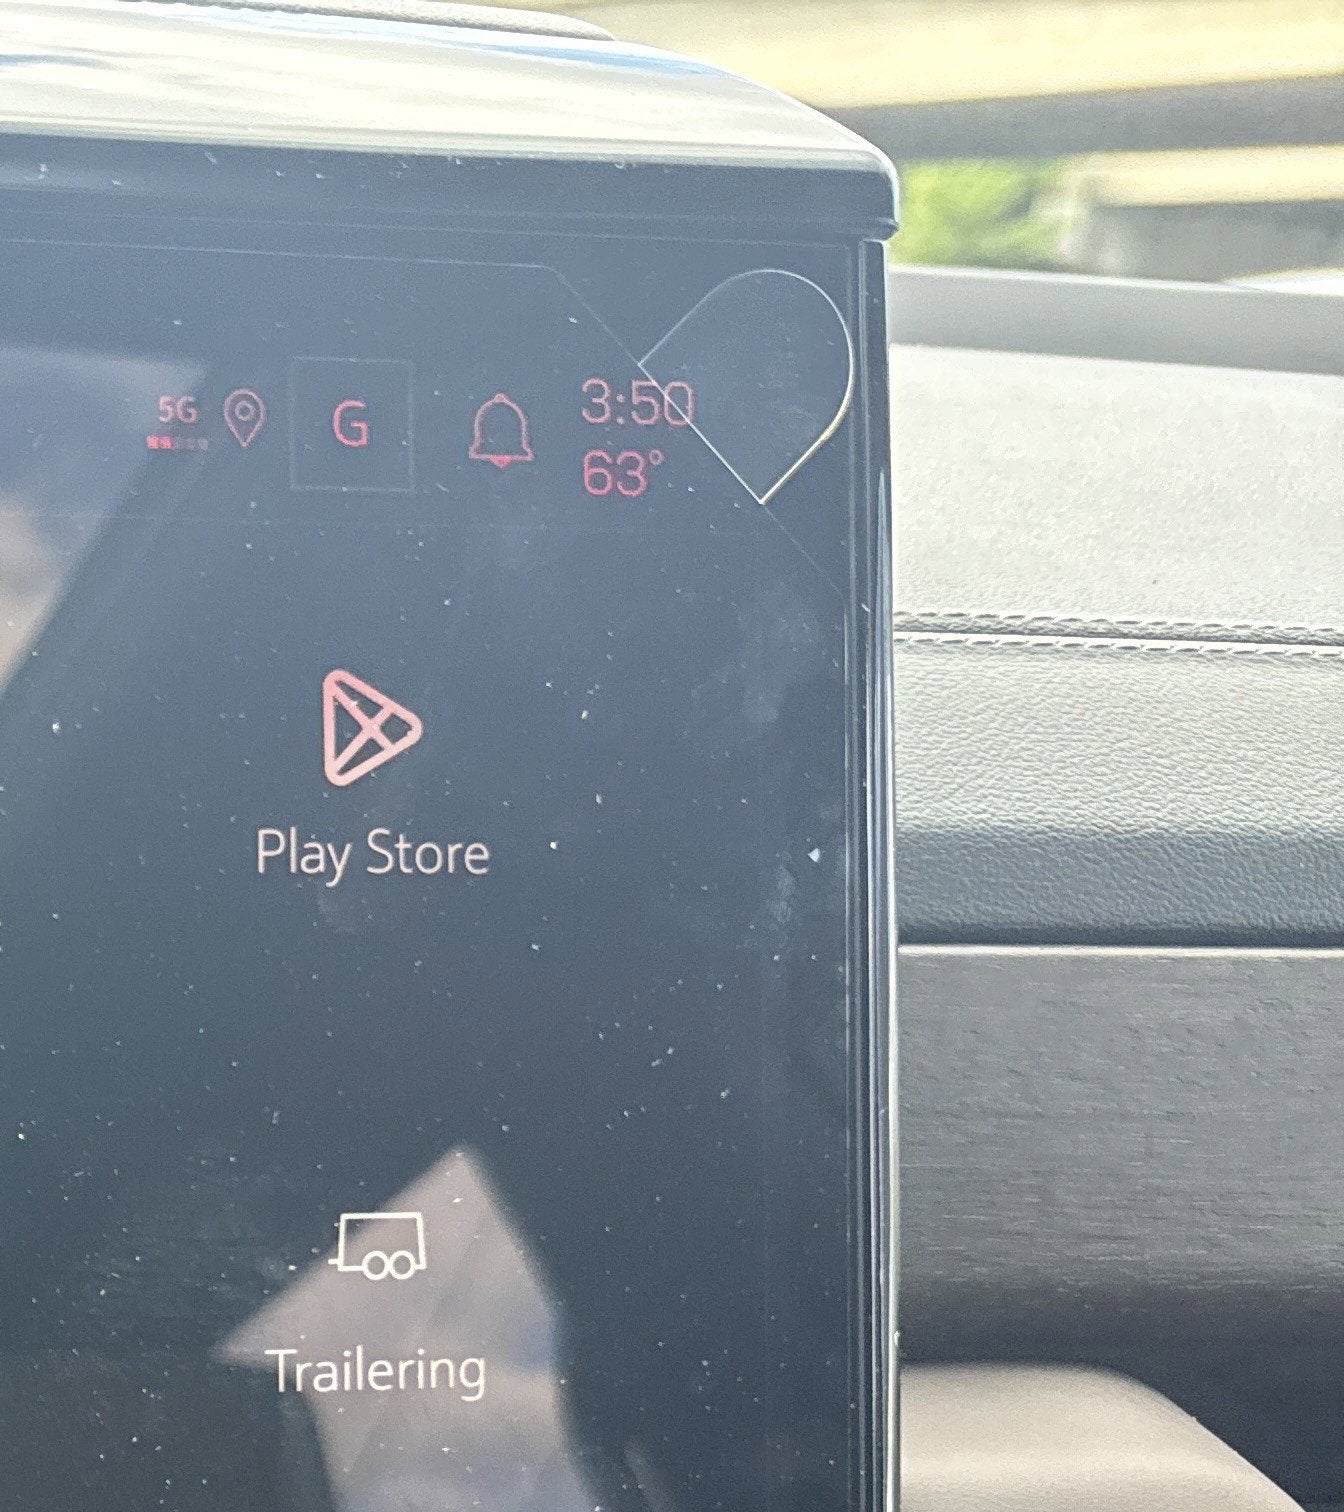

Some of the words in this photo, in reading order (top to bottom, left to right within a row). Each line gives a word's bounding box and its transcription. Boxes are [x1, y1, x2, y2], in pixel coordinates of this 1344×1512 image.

[157, 397, 198, 424] 5G
[331, 399, 369, 449] G
[581, 378, 696, 426] 3:50
[256, 826, 353, 886] Play
[365, 827, 492, 876] Store
[264, 1344, 488, 1402] Trailering
